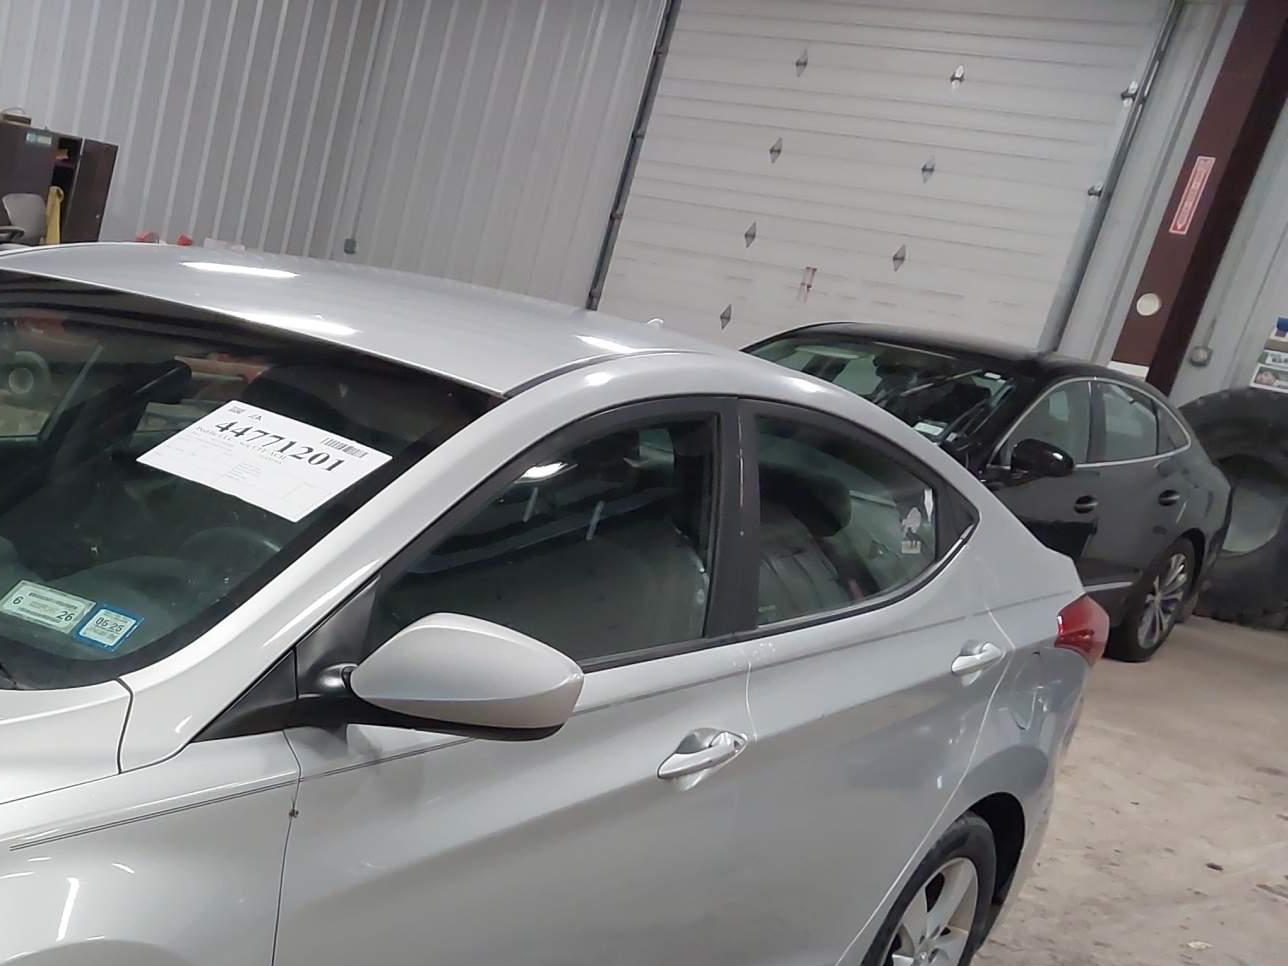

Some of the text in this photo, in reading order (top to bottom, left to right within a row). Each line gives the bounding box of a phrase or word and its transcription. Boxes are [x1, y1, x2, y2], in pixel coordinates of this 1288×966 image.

[215, 421, 345, 471] 44771201
[12, 596, 24, 605] 6
[56, 610, 75, 621] 26
